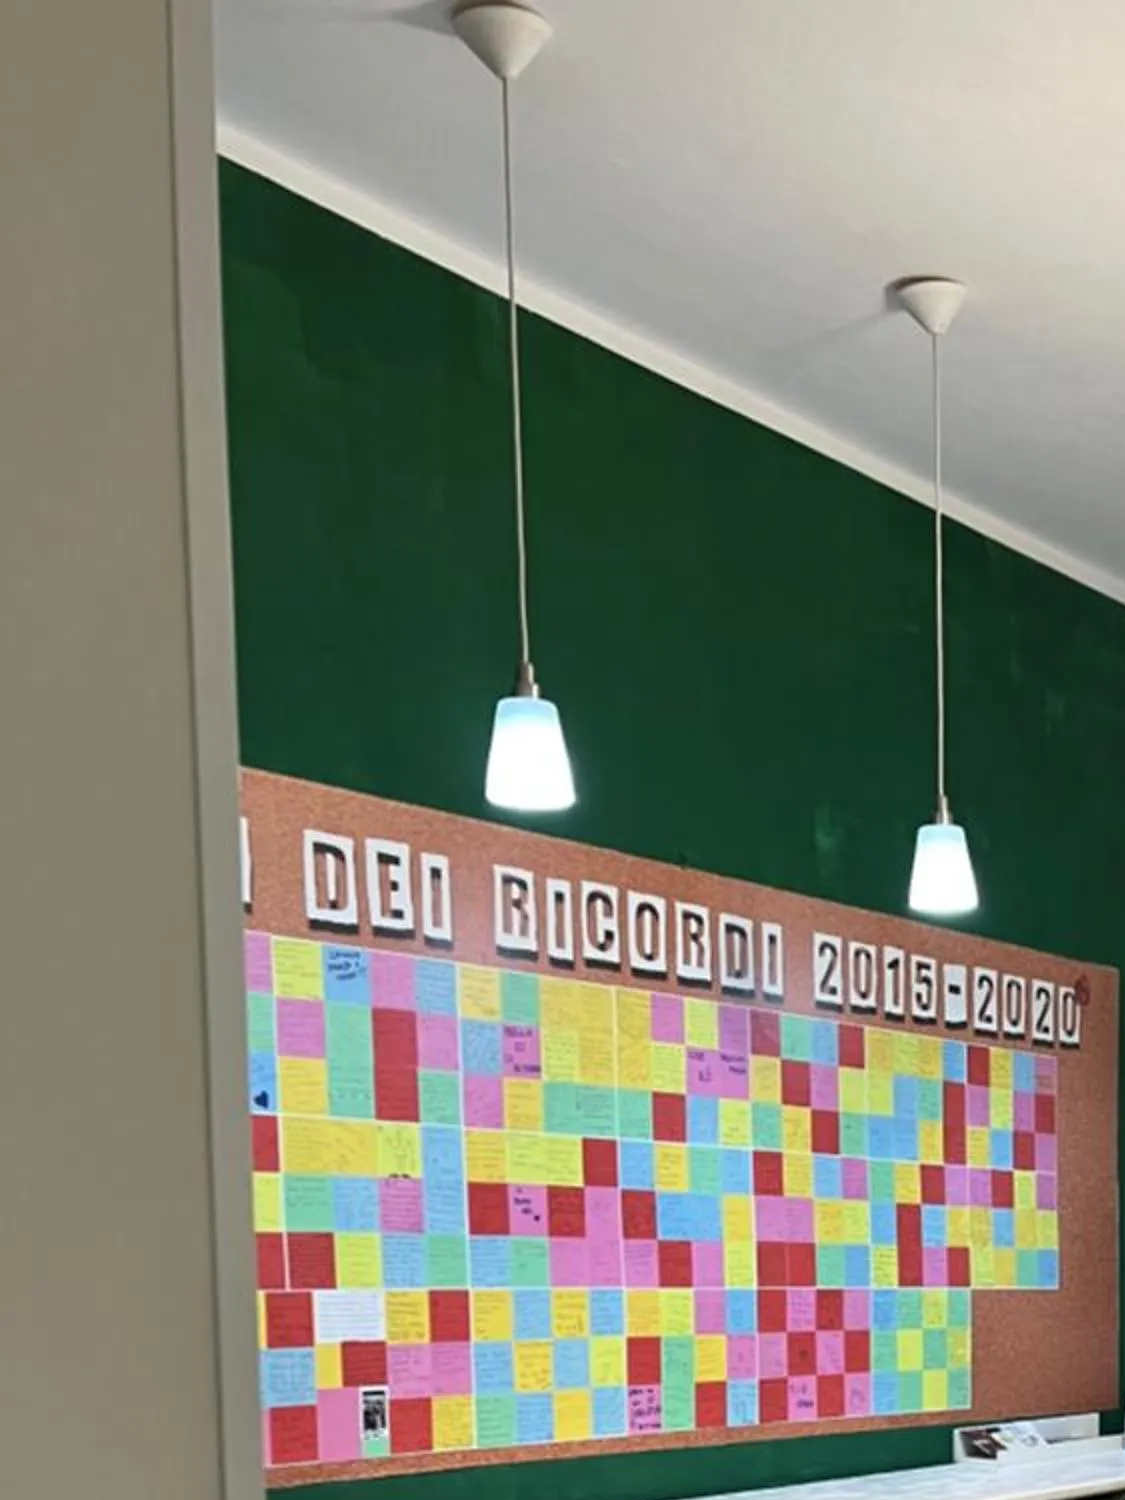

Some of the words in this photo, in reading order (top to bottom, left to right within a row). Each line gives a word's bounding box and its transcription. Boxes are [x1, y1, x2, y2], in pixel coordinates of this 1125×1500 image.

[309, 838, 447, 933] DEI
[498, 870, 779, 992] RICORDI
[815, 939, 1080, 1039] 2015-2020
